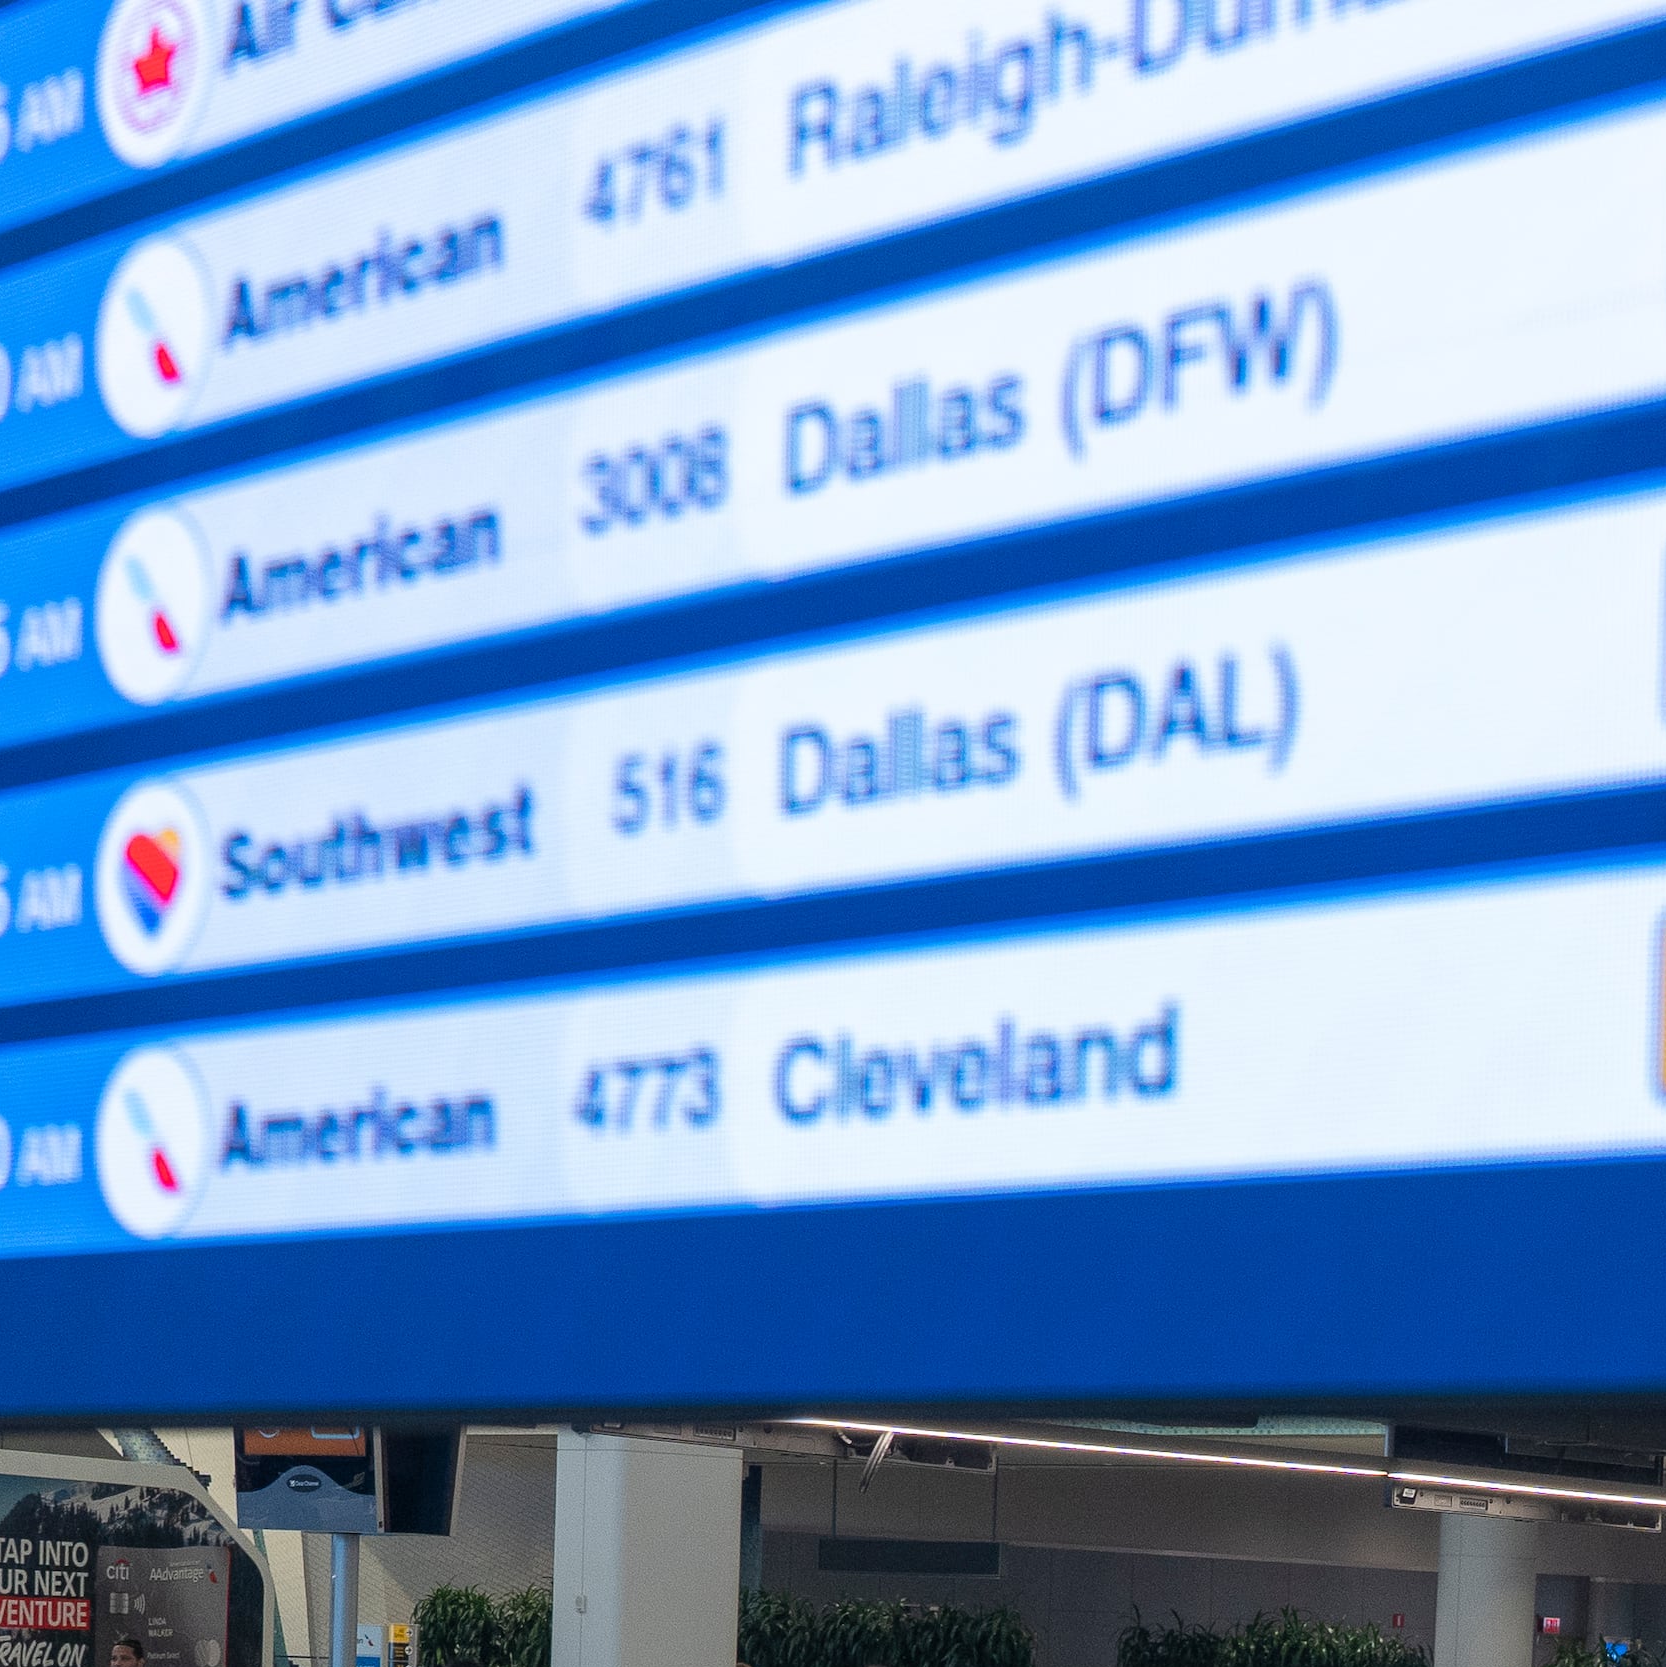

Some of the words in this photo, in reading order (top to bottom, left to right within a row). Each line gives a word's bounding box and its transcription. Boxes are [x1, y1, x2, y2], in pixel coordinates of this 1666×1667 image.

[18, 69, 83, 151] AM
[18, 335, 83, 415] AM
[220, 211, 506, 350] American
[581, 117, 727, 230] 4761
[18, 598, 83, 672] AM
[218, 503, 503, 622] American
[580, 426, 728, 538] 3008
[783, 371, 1027, 496] Dallas
[1060, 273, 1336, 463] (DFW)
[18, 864, 83, 936] AM
[220, 779, 536, 899] Southwest
[611, 738, 724, 836] 516
[779, 707, 1019, 818] Dallas
[1055, 639, 1303, 801] (DAL)
[20, 1124, 83, 1187] AM
[220, 1078, 497, 1173] American
[576, 1045, 721, 1133] 4773
[774, 994, 1183, 1125] Cleveland
[38, 1540, 89, 1567] INTO
[34, 1570, 89, 1597] NEXT
[106, 1561, 129, 1580] citi
[149, 1567, 204, 1582] AAdvantage
[148, 1628, 173, 1638] WALKER
[57, 1644, 86, 1667] ON
